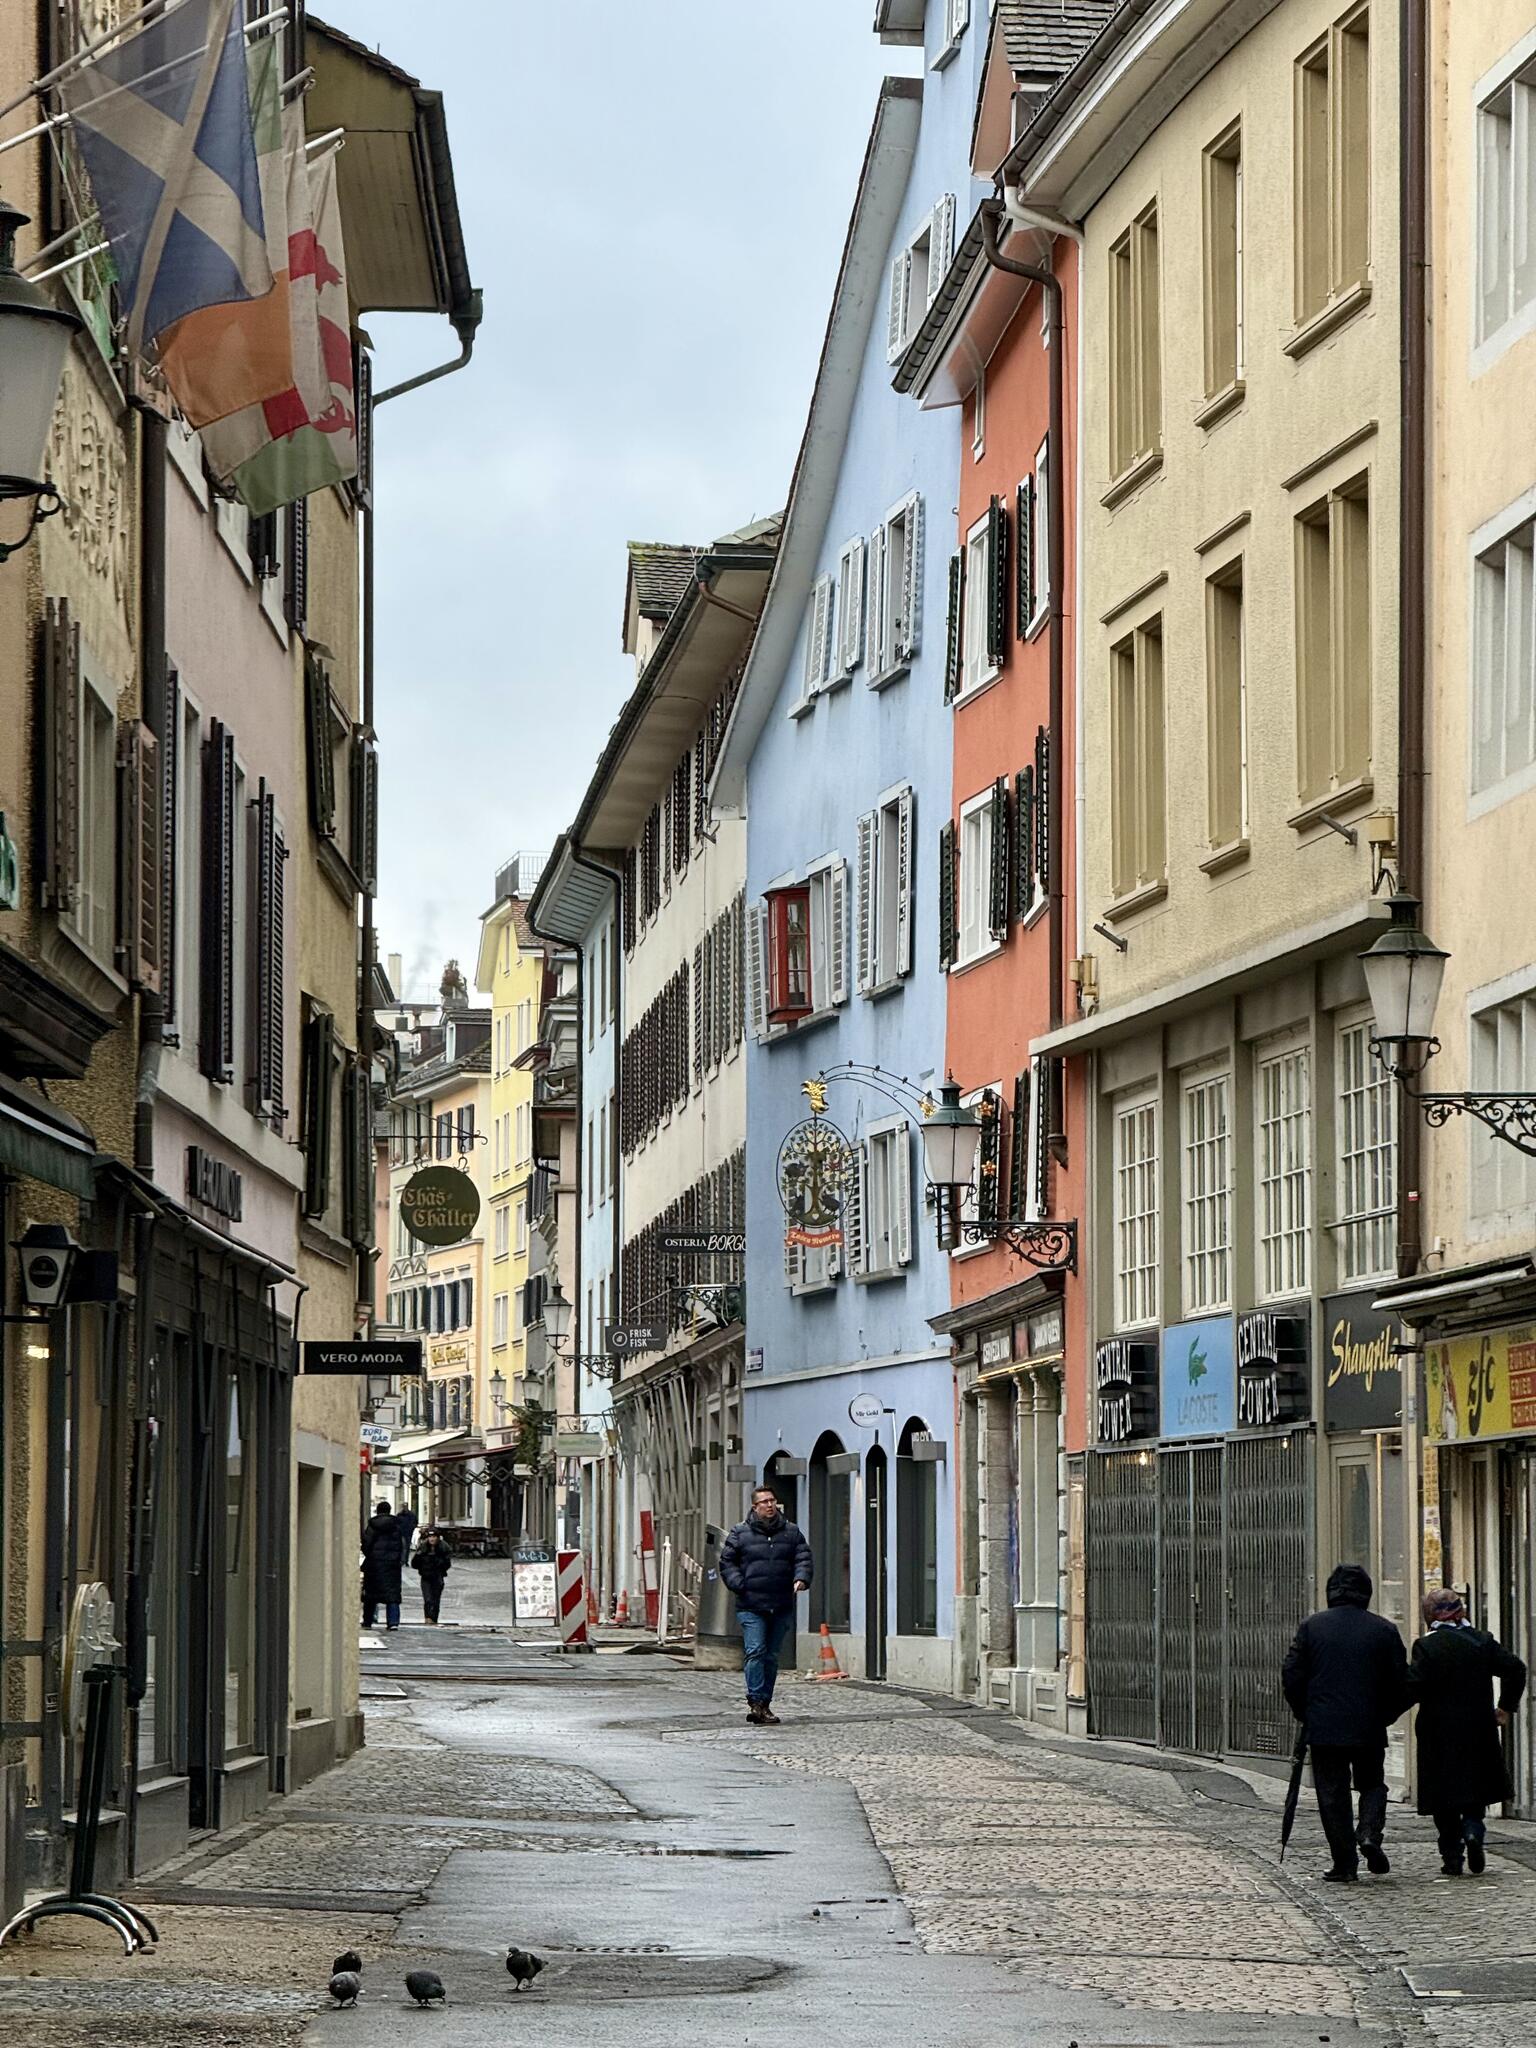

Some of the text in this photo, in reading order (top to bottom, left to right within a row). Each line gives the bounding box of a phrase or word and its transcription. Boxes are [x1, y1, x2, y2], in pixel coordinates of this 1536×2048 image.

[664, 1238, 707, 1247] OSTERIA
[629, 1328, 652, 1338] FRISK
[629, 1338, 648, 1347] FISK
[1237, 1313, 1278, 1368] CENTRAL
[320, 1353, 404, 1363] VERO MODA
[1097, 1340, 1132, 1391] CENTRAL
[1177, 1393, 1219, 1426] LACOSTE
[1239, 1371, 1280, 1424] POWER
[1098, 1392, 1132, 1441] POWER
